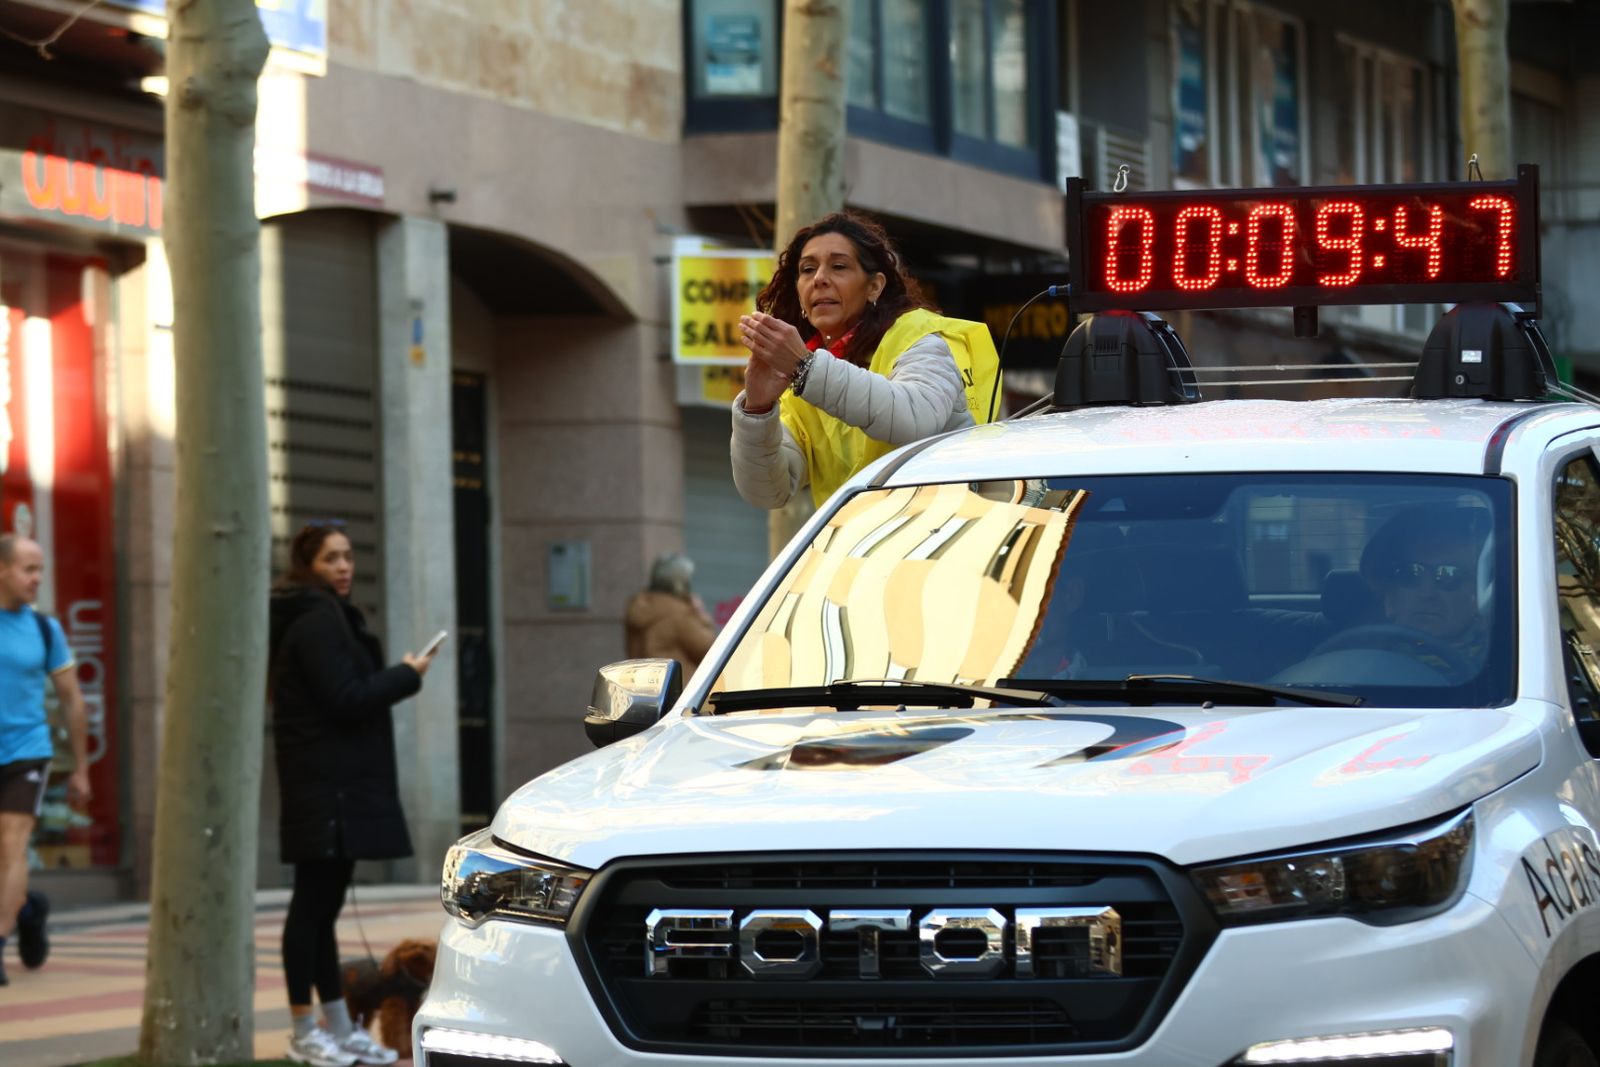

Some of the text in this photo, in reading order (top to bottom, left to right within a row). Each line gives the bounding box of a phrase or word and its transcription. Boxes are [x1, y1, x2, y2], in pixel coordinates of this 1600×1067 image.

[1106, 197, 1513, 292] 00:09:47
[682, 320, 739, 346] SAL
[644, 907, 1122, 979] FOTON
